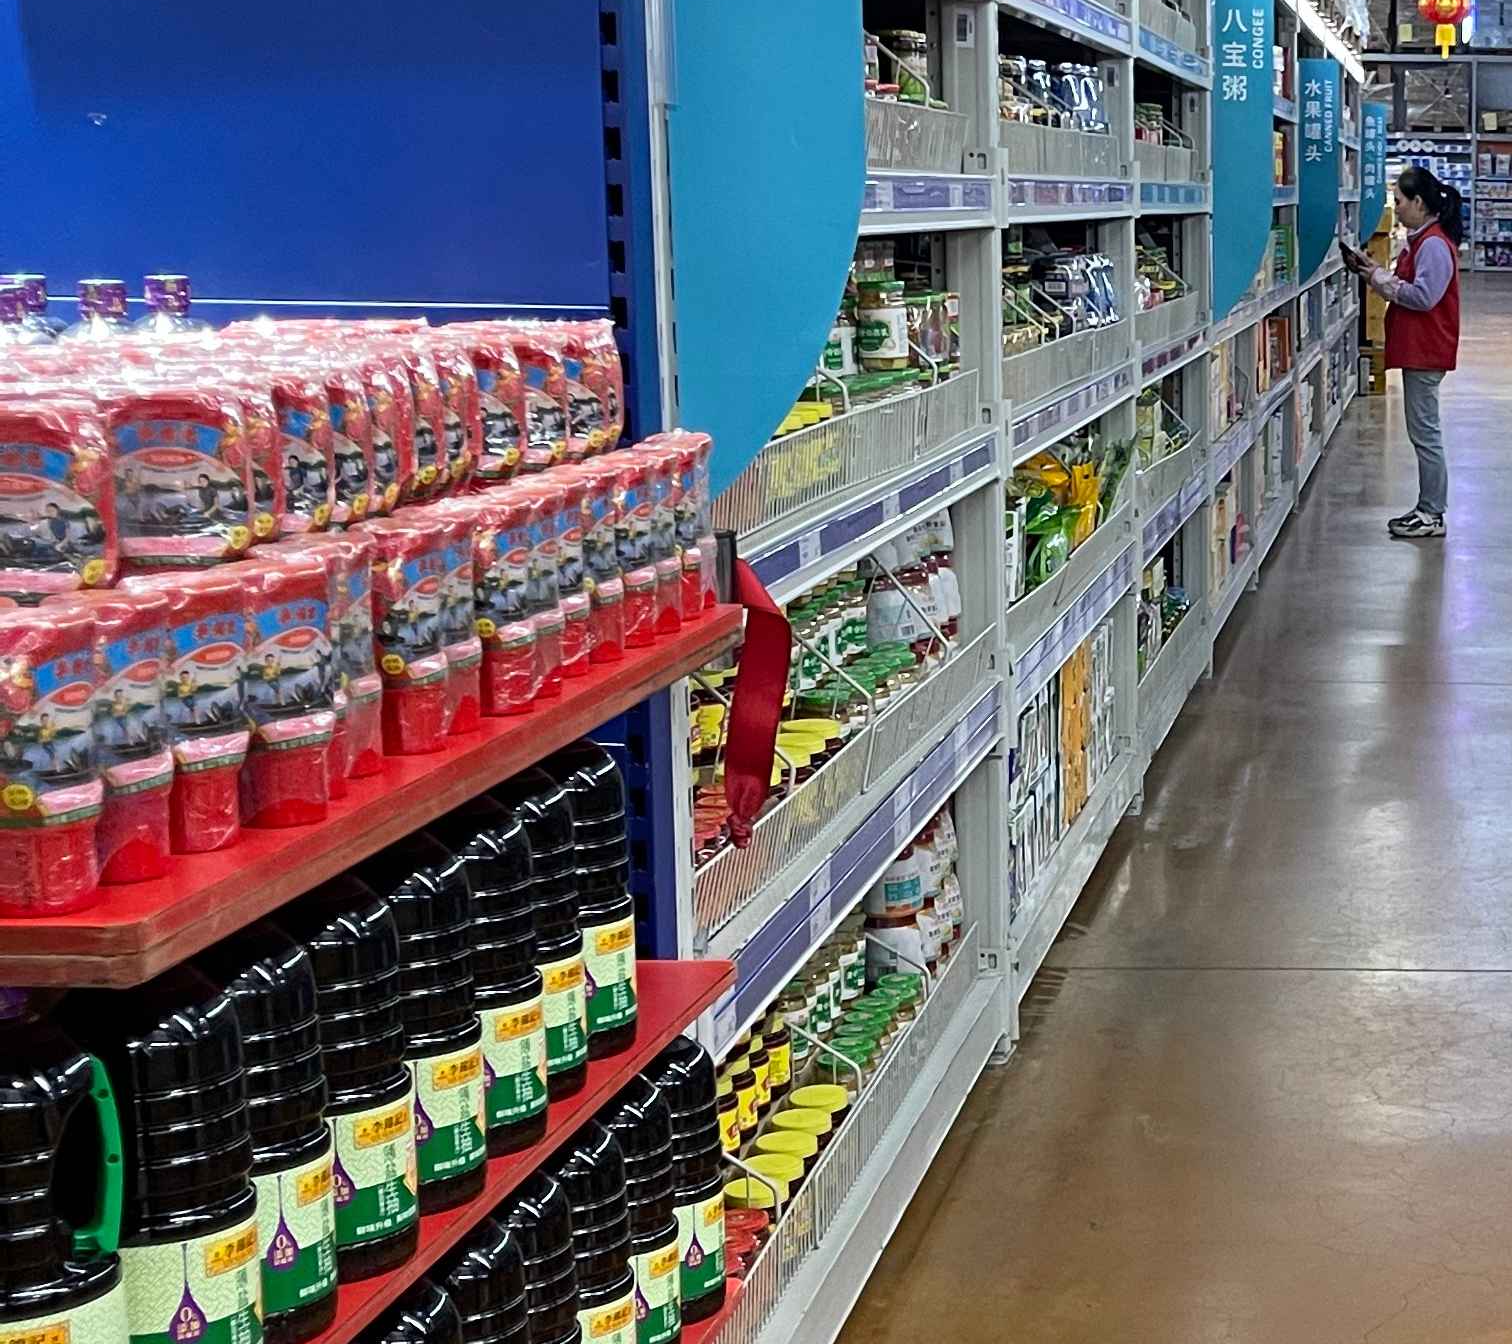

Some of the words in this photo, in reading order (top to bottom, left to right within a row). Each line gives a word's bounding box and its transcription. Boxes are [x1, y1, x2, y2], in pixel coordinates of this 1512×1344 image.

[1222, 8, 1248, 102] 八宝粥
[1252, 8, 1264, 69] CONGEE
